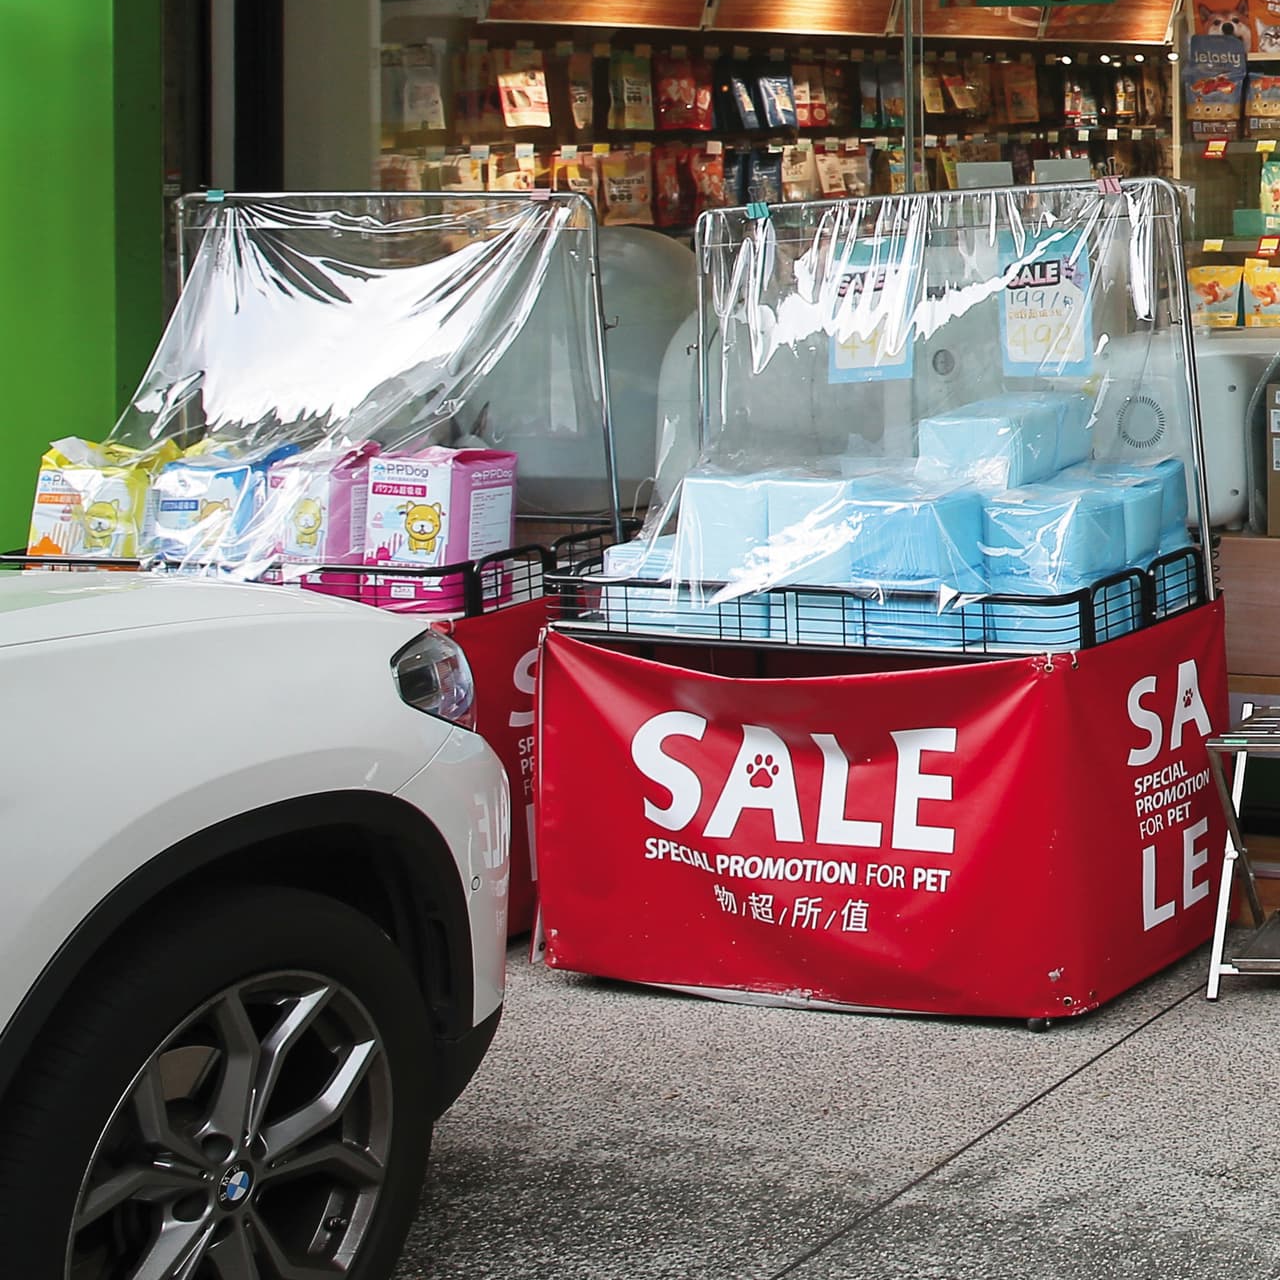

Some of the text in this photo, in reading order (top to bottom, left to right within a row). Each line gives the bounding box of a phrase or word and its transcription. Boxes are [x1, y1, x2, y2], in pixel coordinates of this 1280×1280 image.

[631, 710, 957, 854] SALE
[1133, 761, 1189, 795] SPECIAL
[1135, 767, 1211, 817] PROMOTION
[1139, 802, 1193, 840] FOR PET
[644, 837, 951, 893] SPECIAL PROMOTION FOR PET
